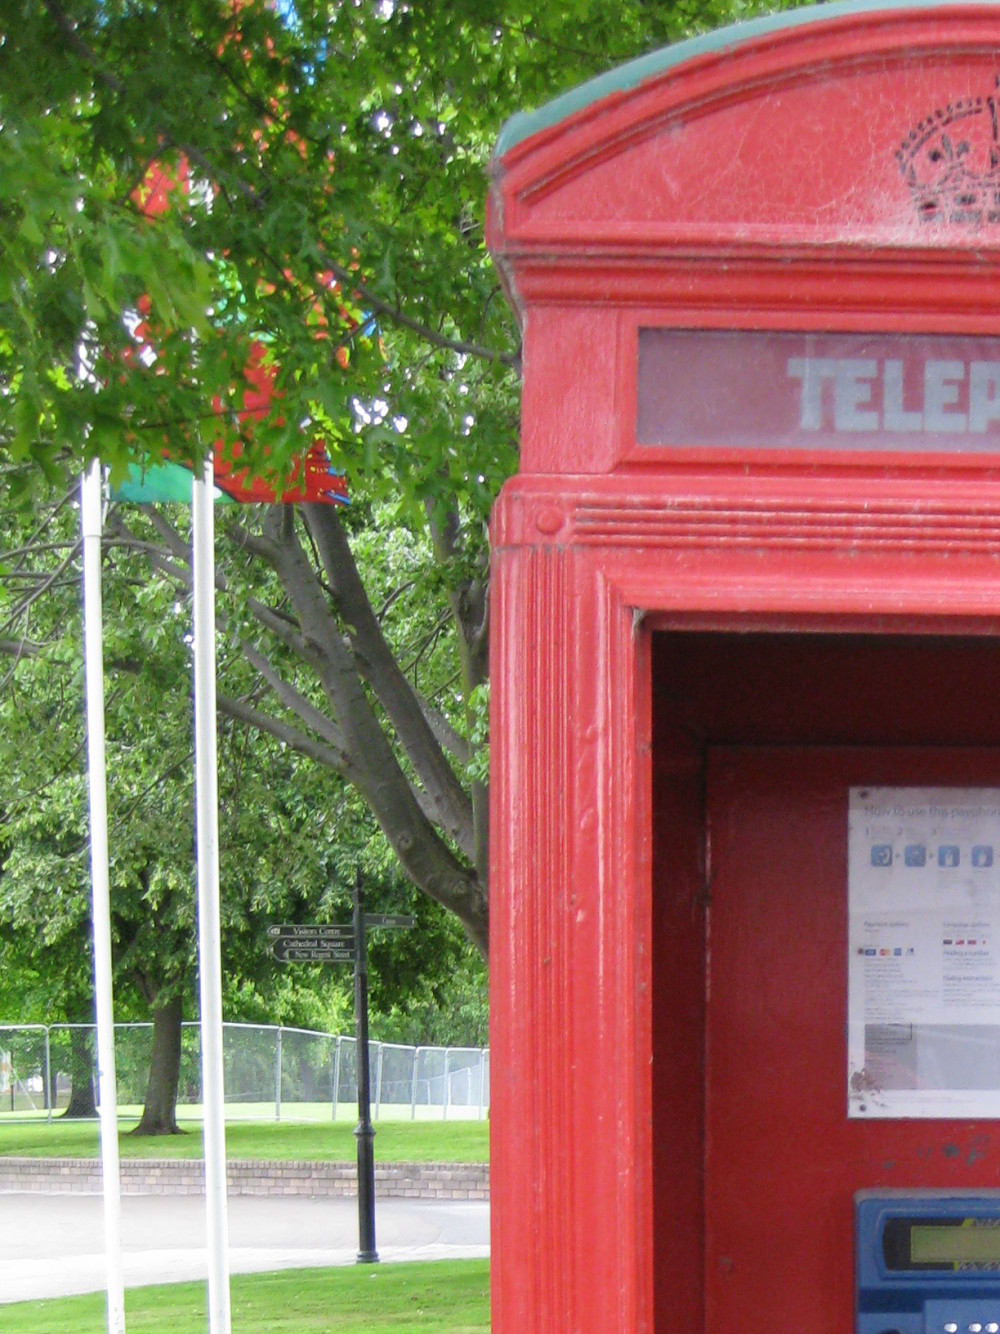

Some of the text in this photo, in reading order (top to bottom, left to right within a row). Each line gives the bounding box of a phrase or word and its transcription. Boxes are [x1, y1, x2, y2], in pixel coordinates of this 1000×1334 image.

[865, 806, 890, 817] How
[293, 927, 341, 935] Visitors Centre
[283, 940, 345, 949] Cathedral Square
